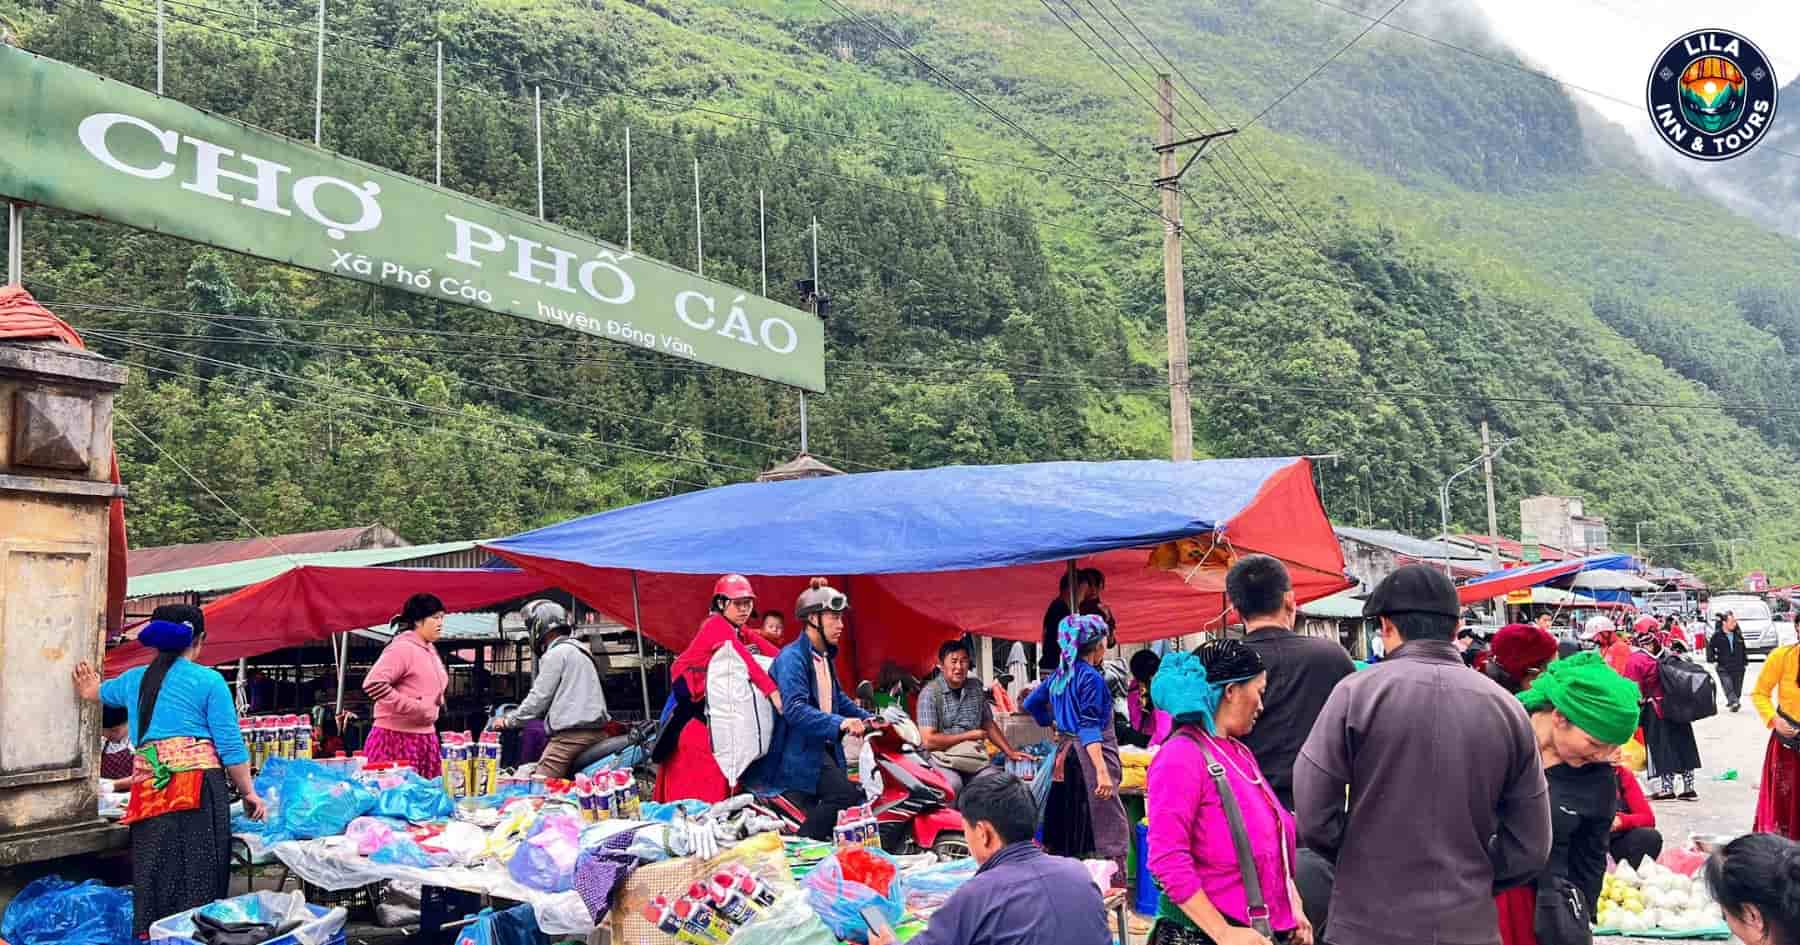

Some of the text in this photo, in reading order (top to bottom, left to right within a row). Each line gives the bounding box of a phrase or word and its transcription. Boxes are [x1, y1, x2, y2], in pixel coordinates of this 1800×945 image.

[78, 113, 382, 240] CHỢ
[674, 294, 798, 354] CÁO
[331, 248, 373, 275] Xã
[381, 261, 433, 289] Phố
[439, 277, 493, 304] Cáo
